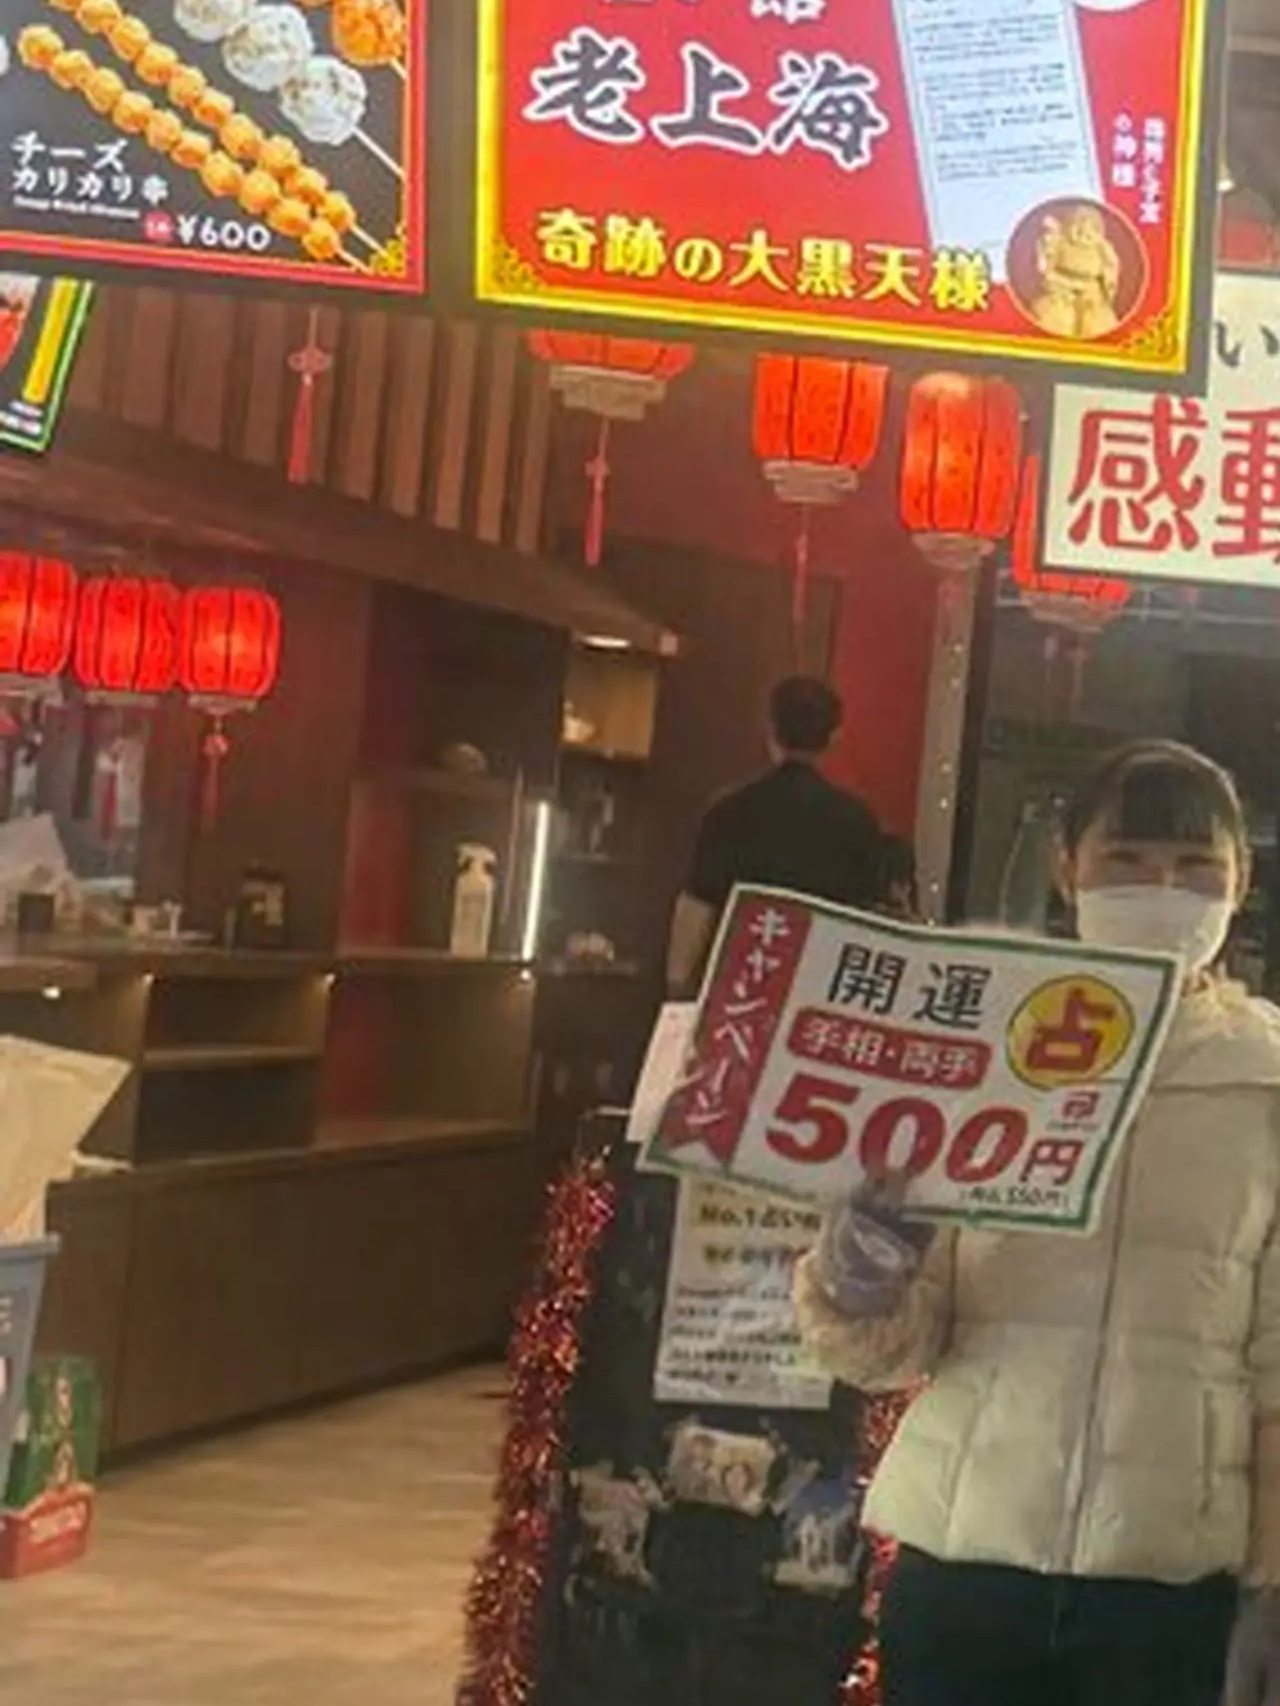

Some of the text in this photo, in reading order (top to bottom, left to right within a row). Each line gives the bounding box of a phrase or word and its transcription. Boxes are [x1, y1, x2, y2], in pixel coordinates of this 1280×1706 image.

[528, 29, 888, 169] 老上海
[11, 131, 128, 172] チーズ
[177, 213, 271, 250] ¥600
[536, 207, 991, 311] 奇跡の大黒天様
[684, 906, 791, 1126] キャンペーン
[826, 941, 994, 1031] 開運
[1024, 985, 1116, 1073] 占
